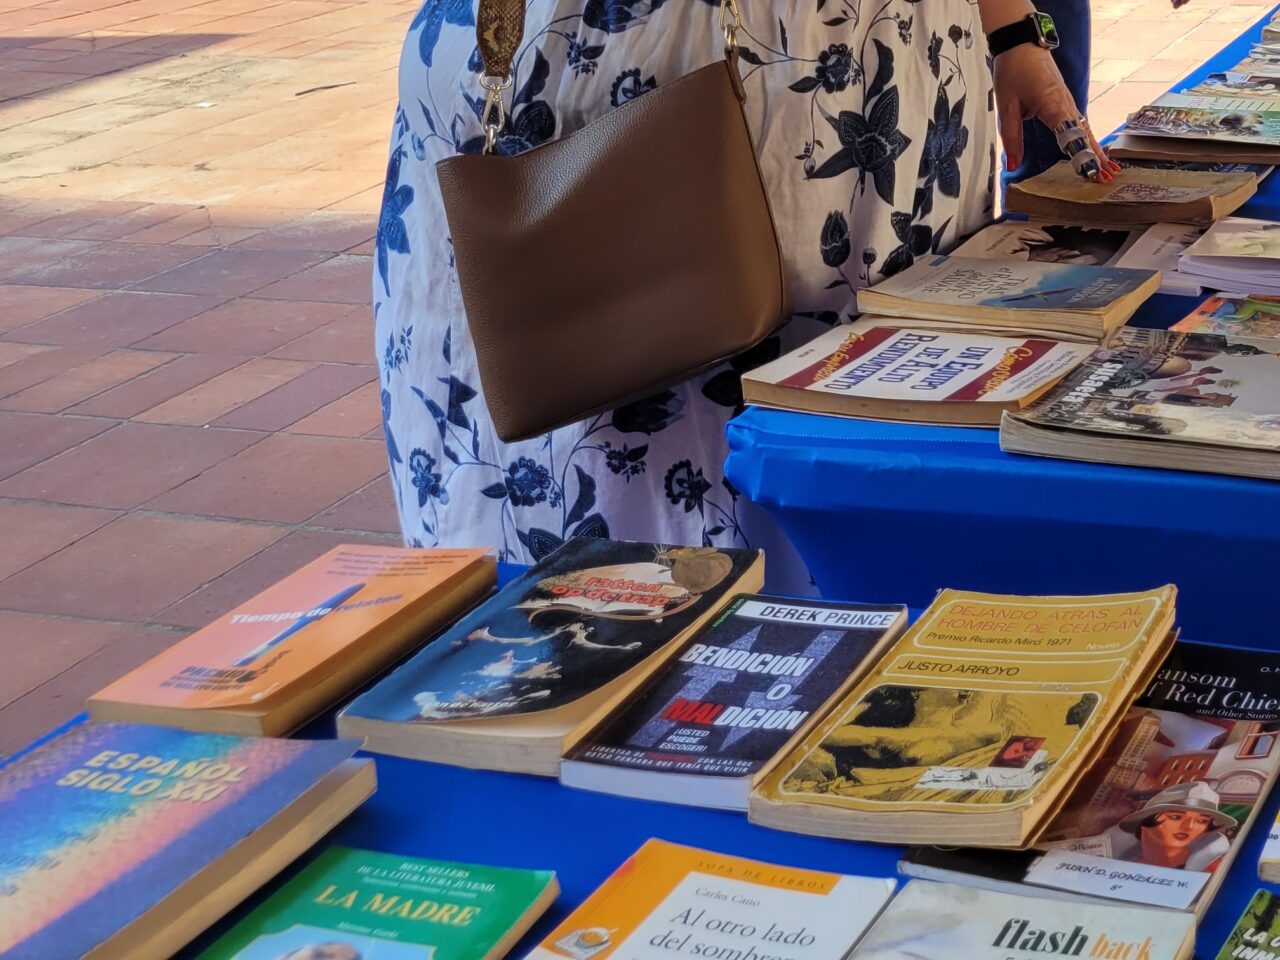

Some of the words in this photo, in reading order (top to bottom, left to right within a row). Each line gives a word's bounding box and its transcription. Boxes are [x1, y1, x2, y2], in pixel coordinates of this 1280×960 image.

[823, 332, 941, 391] RENDIMIENTO
[927, 347, 951, 360] DE
[876, 359, 941, 383] ALTO
[229, 606, 301, 625] Tiempo
[760, 605, 823, 622] DEREK
[824, 610, 894, 626] PRINCE
[949, 604, 1039, 621] DEJANDO
[1048, 608, 1110, 621] ATRAS
[1120, 605, 1143, 617] AL
[936, 617, 1017, 634] HOMBRE
[1023, 622, 1050, 634] DE
[1058, 618, 1145, 635] CELOFAN
[926, 631, 969, 644] Premio
[969, 634, 1014, 645] Ricardo
[1046, 637, 1074, 647] 1971
[679, 643, 816, 677] BENDICIÓN
[898, 660, 954, 673] JUSTO
[951, 663, 1021, 677] ARROYO
[1157, 668, 1238, 689] ansom
[766, 683, 792, 701] O
[1163, 683, 1217, 707] Red
[660, 698, 810, 731] MALDICIÓN
[1196, 707, 1217, 717] and
[1217, 708, 1245, 719] Other
[1245, 711, 1279, 720] Stories
[666, 735, 701, 744] PUEDE
[84, 750, 249, 783] ESPAÑOL
[716, 758, 735, 767] LAS
[56, 769, 162, 796] SIGLO
[157, 781, 230, 802] XXI
[400, 862, 427, 873] BEST
[743, 868, 764, 881] DE
[1055, 862, 1096, 875] JUAN
[1109, 869, 1175, 888] GONZÁLEZ
[1175, 879, 1189, 889] W.
[314, 884, 360, 909] LA
[362, 892, 483, 928] MADRE
[695, 887, 730, 902] Carles
[731, 893, 762, 908] Cano
[670, 906, 703, 927] Al
[704, 917, 757, 938] otro
[761, 922, 817, 947] lado
[1242, 927, 1269, 943] LA
[649, 929, 693, 951] del
[991, 917, 1090, 956] flash
[1088, 932, 1156, 960] back
